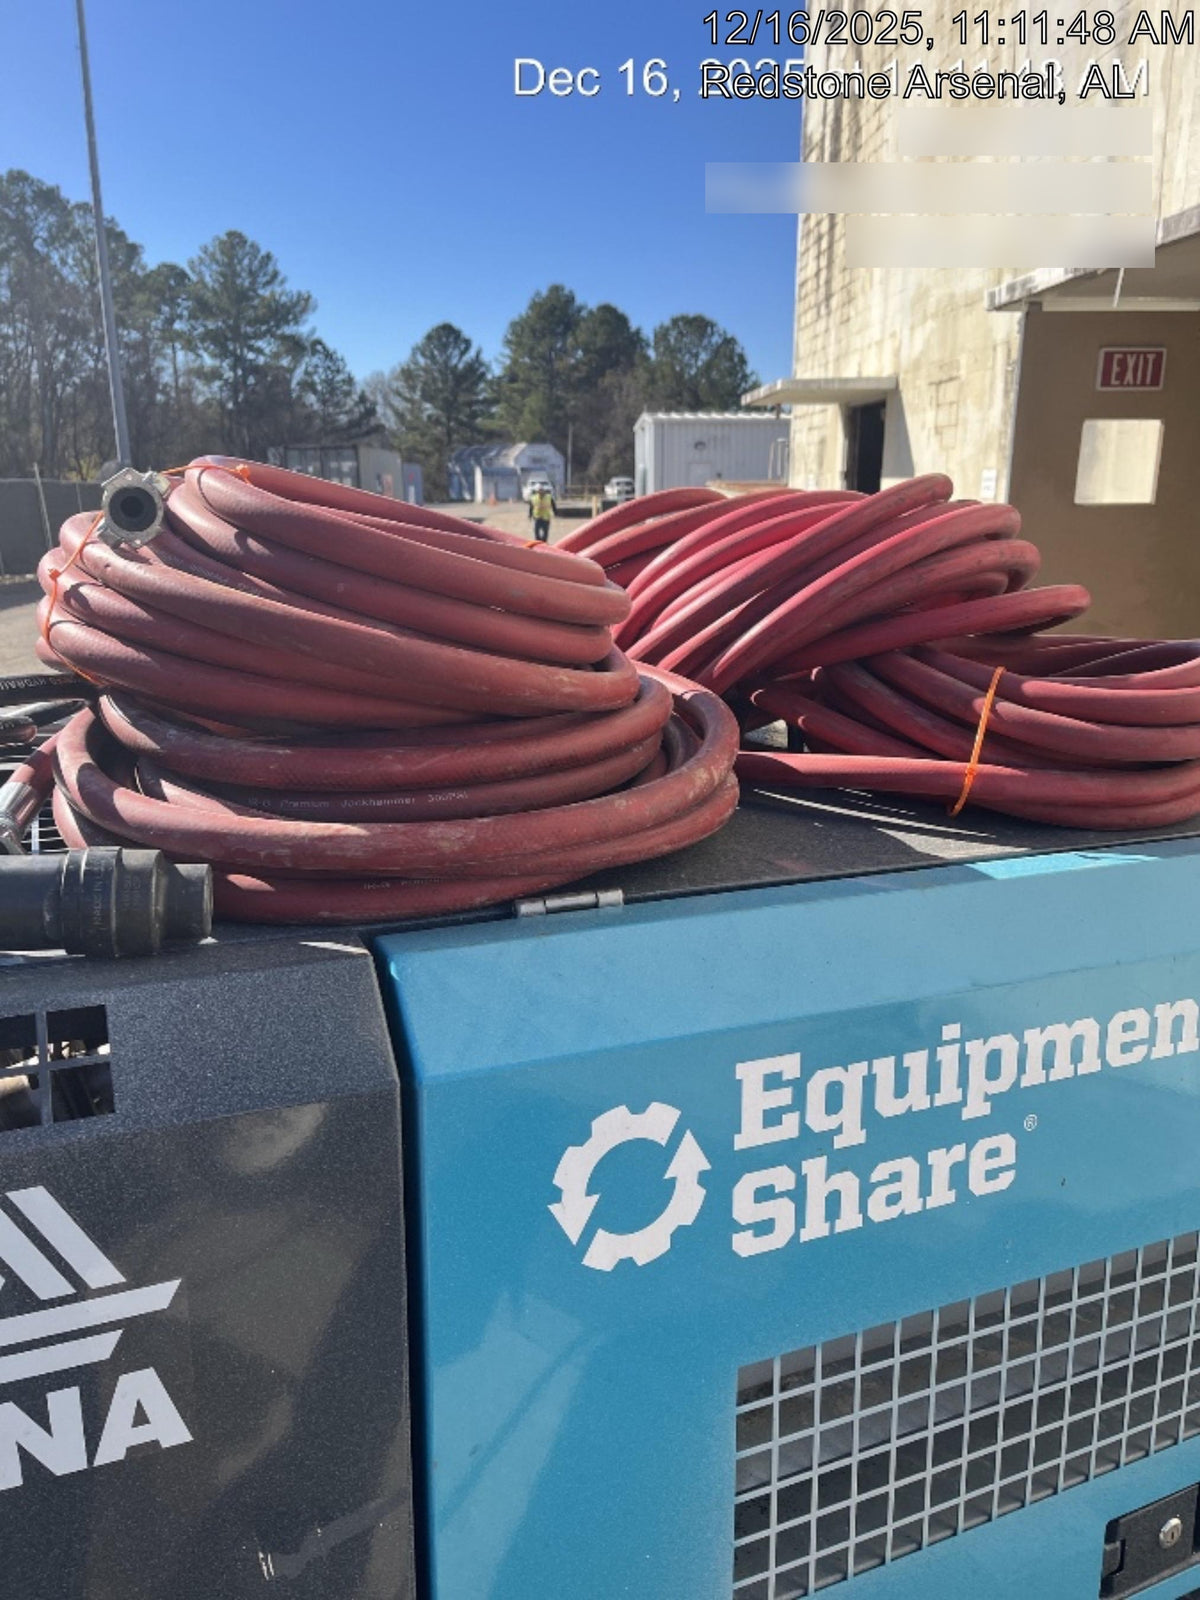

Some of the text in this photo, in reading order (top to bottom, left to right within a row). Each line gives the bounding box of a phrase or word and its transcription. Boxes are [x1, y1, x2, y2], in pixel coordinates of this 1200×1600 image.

[1110, 353, 1157, 386] EXIT
[734, 998, 1200, 1150] Equipmen
[732, 1132, 1018, 1258] Share
